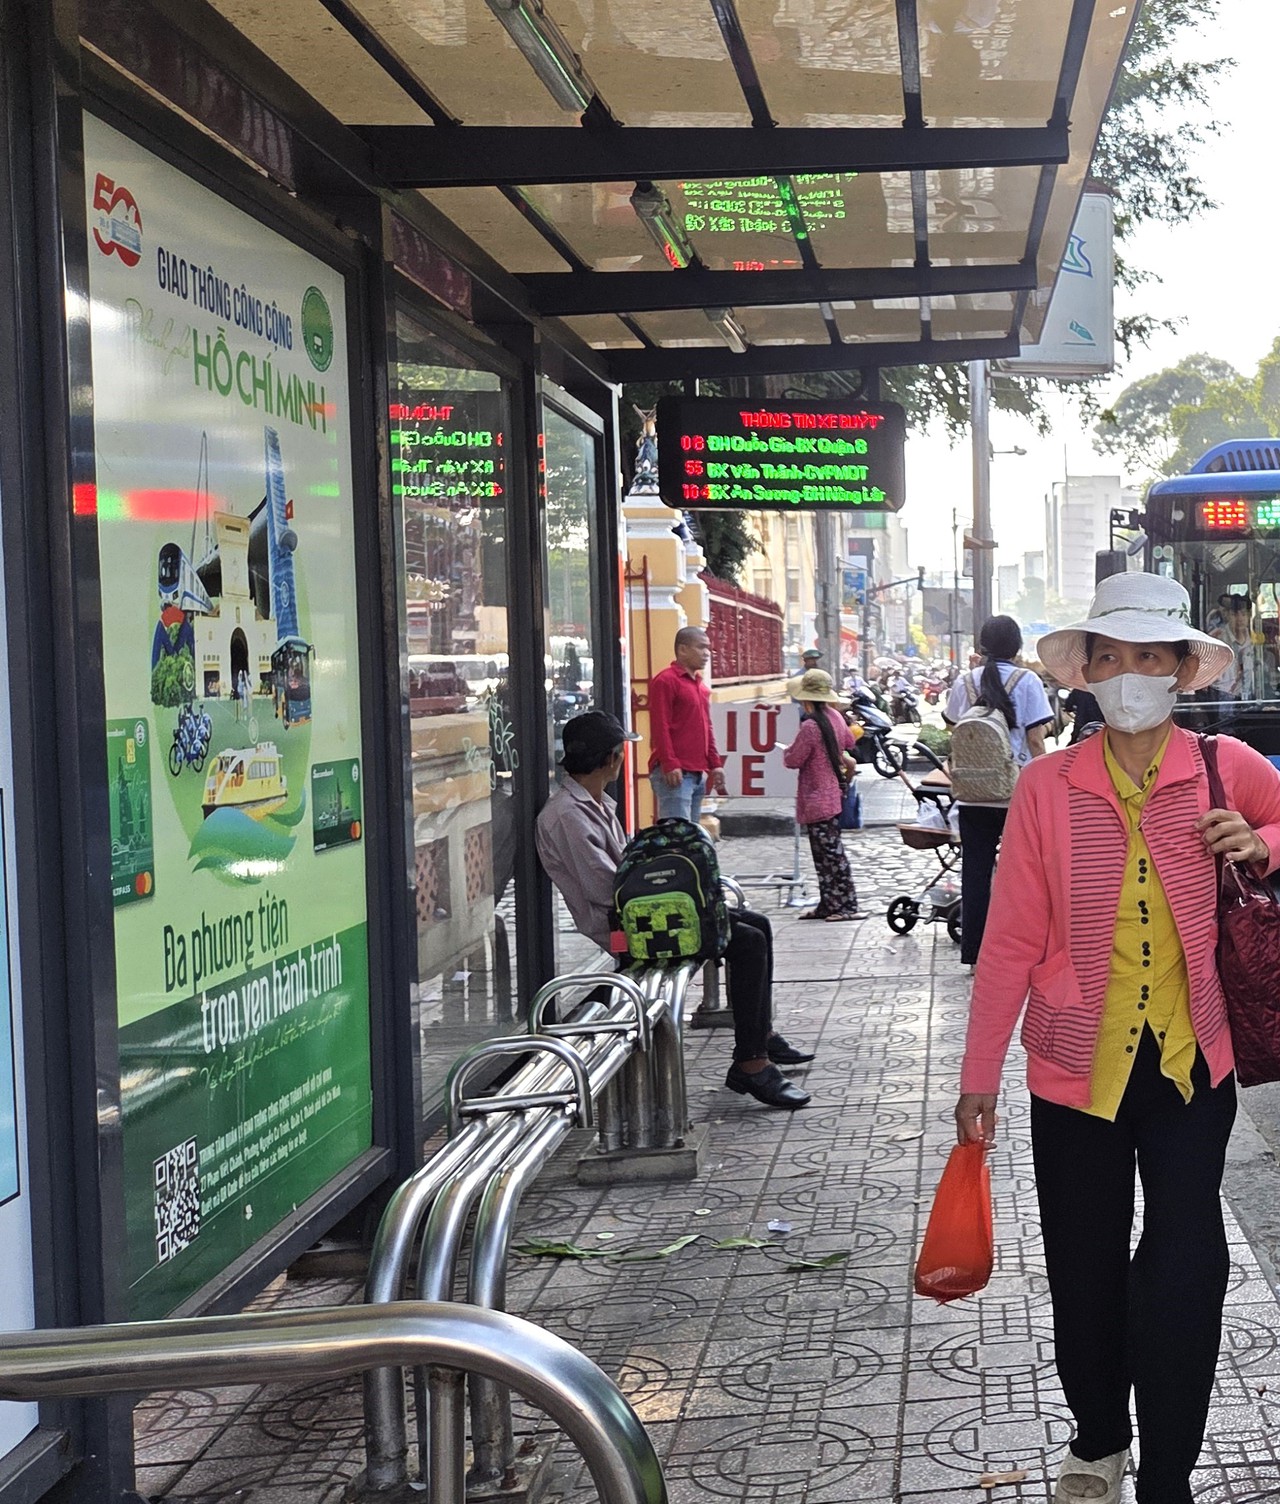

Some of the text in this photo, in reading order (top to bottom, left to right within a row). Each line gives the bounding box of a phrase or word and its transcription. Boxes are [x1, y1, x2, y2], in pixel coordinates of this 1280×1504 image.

[157, 246, 293, 352] GIAO THÔNG CÔNG CỘNG
[192, 326, 326, 434] HỒ CHÍ MINH
[726, 703, 781, 753] IỮ
[163, 889, 289, 995] Đa phương tiện
[200, 990, 240, 1054] trọn
[241, 975, 270, 1037] vẹn
[272, 947, 309, 1018] hành
[310, 931, 343, 998] trình
